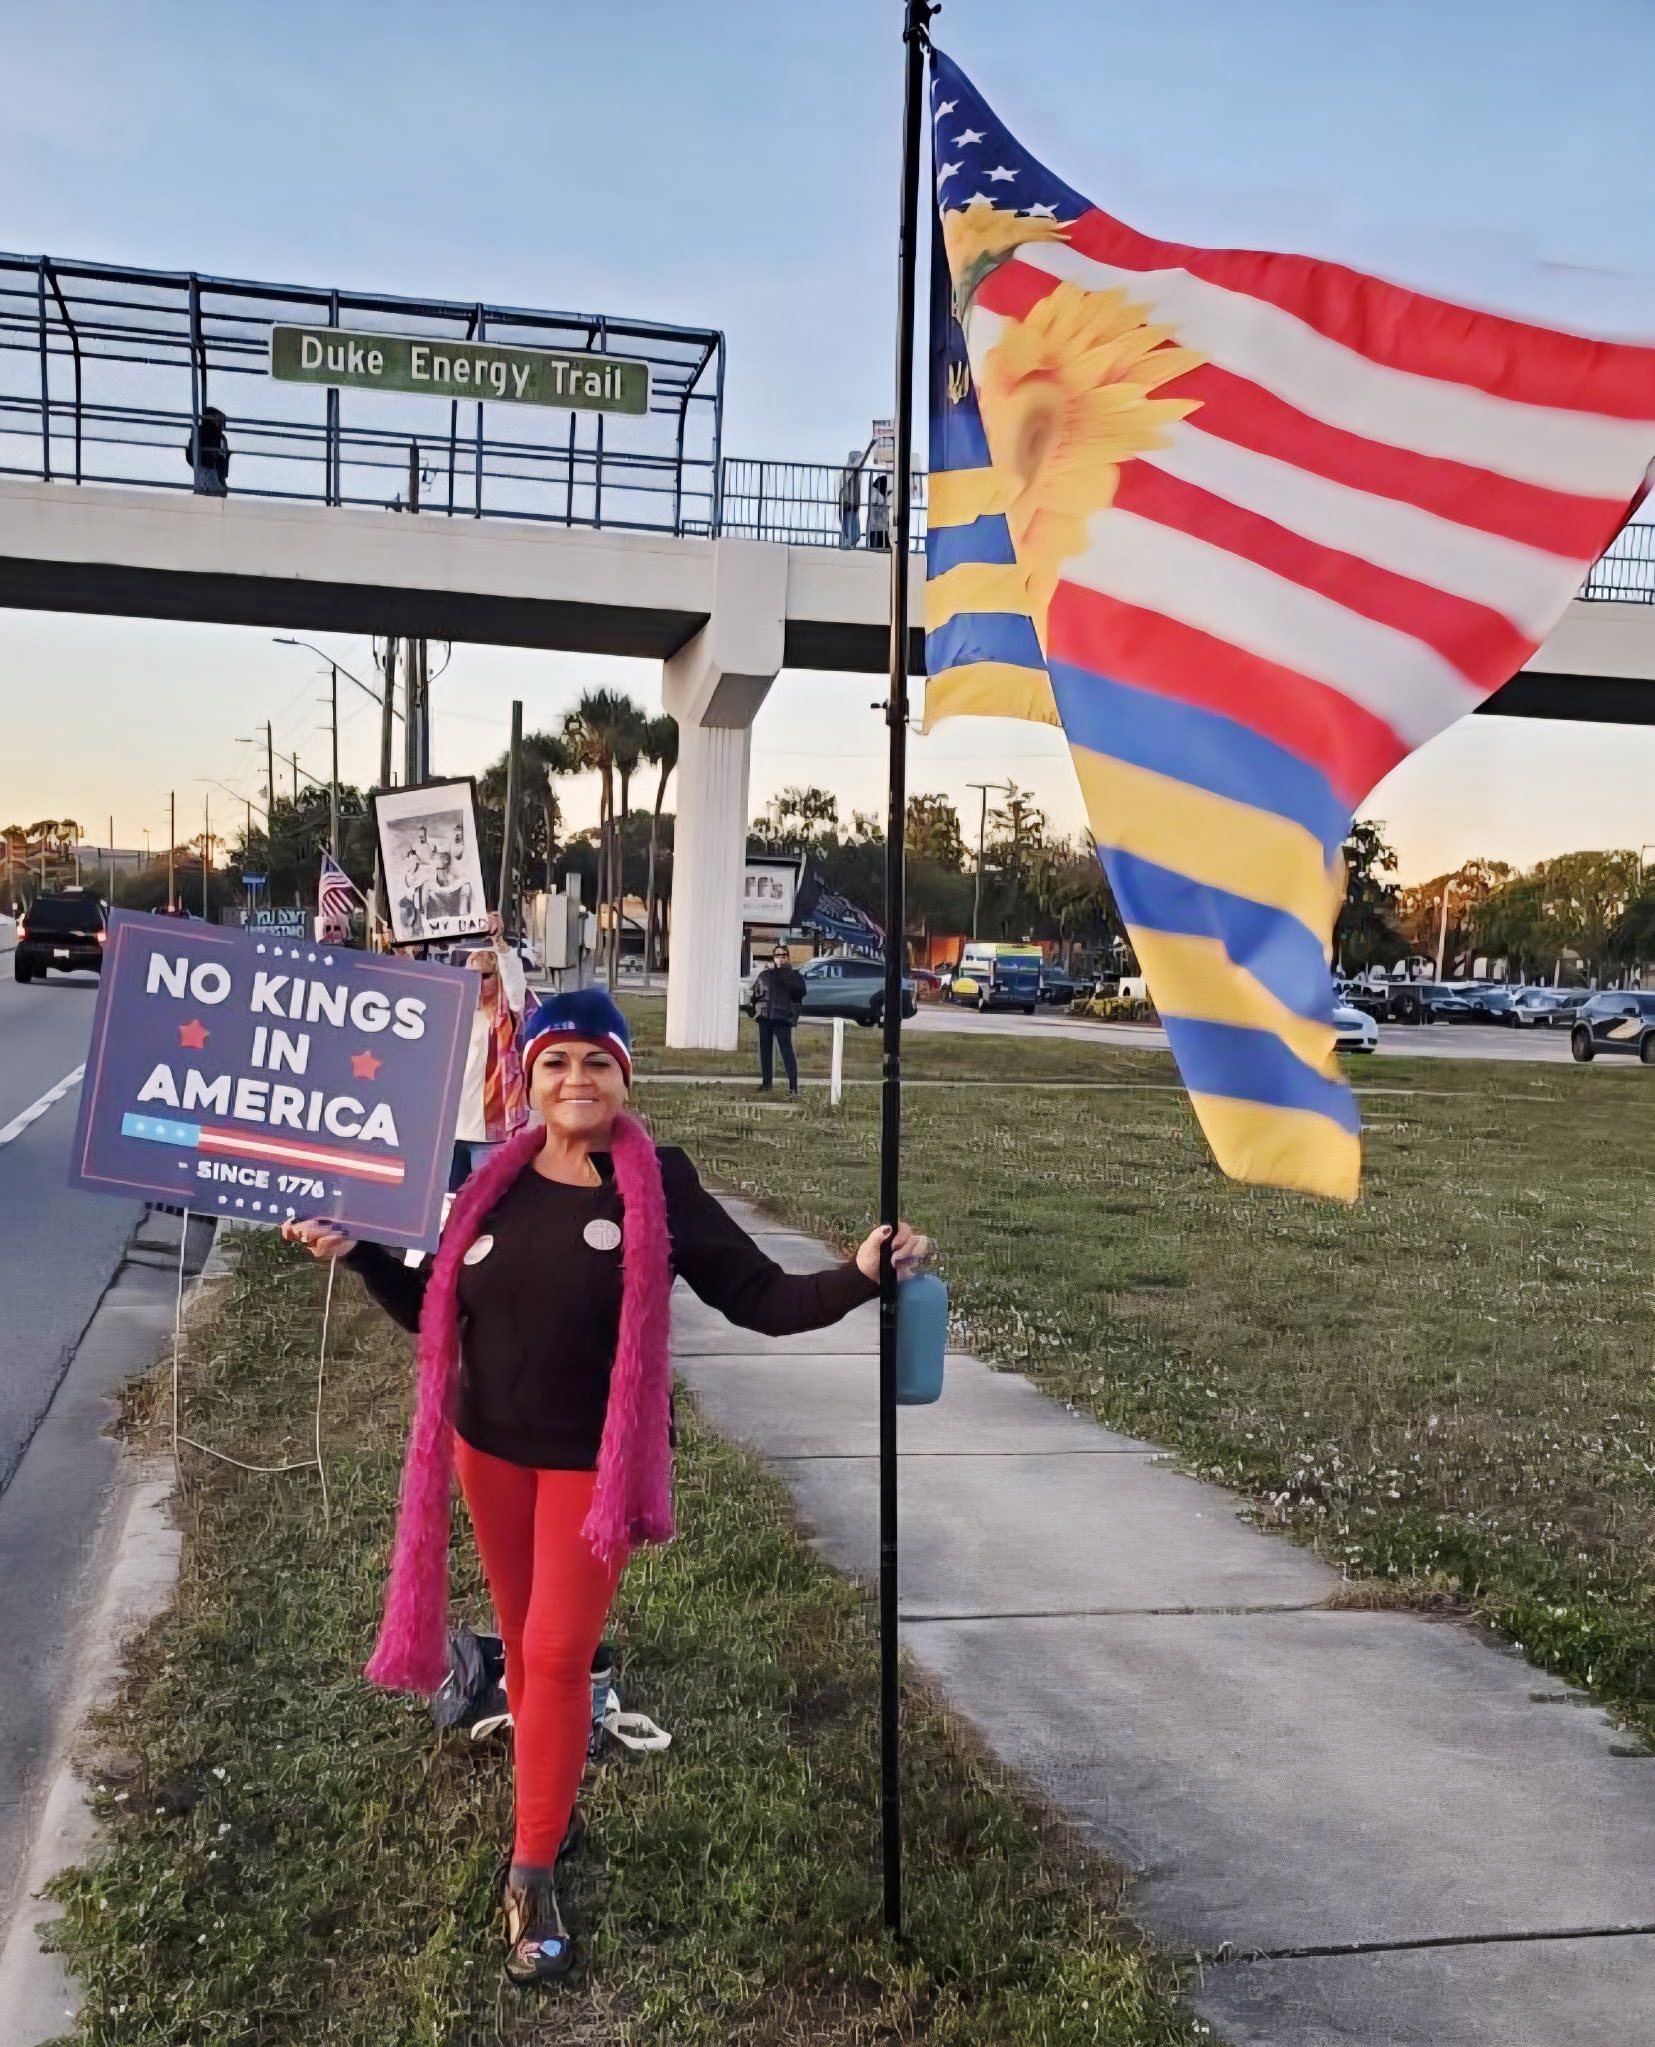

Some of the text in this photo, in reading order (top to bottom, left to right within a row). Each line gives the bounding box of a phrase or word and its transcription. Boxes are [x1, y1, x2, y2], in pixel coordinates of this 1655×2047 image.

[301, 335, 622, 400] Duke Energy Trail
[146, 952, 427, 1040] NO KINGS
[251, 1026, 310, 1075] IN
[137, 1063, 400, 1147] AMERICA
[197, 1160, 325, 1199] SINCE 1776
